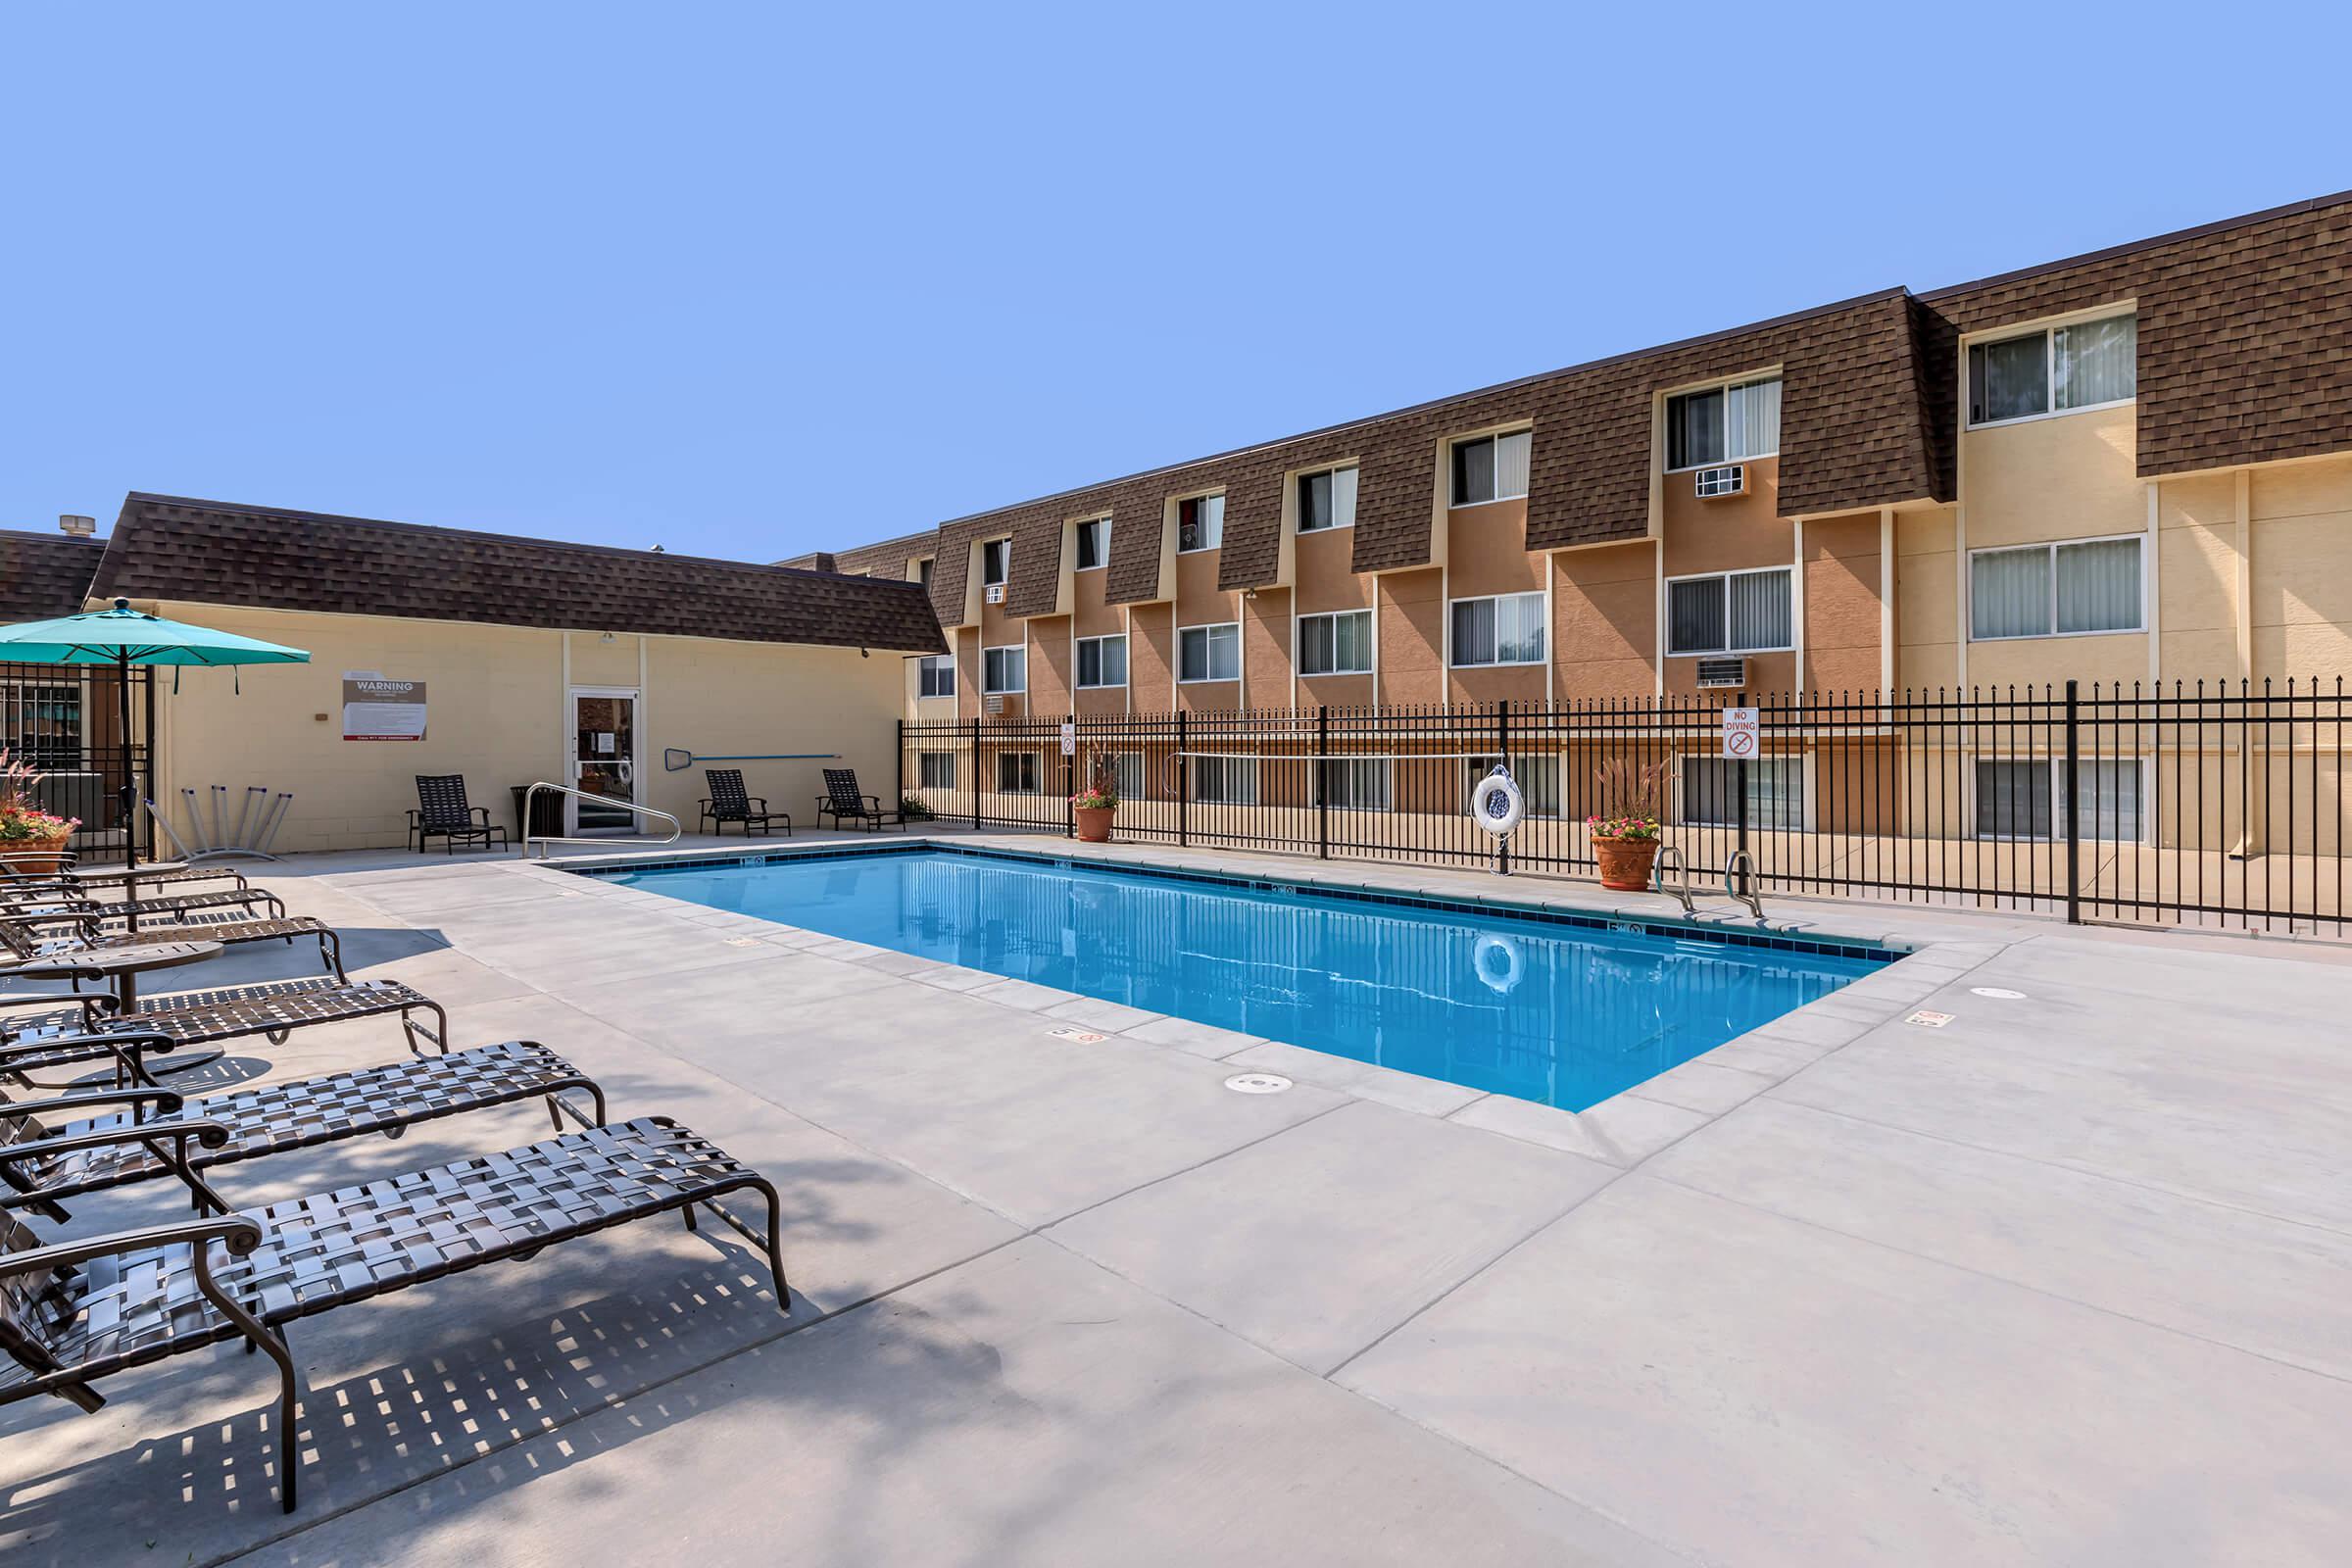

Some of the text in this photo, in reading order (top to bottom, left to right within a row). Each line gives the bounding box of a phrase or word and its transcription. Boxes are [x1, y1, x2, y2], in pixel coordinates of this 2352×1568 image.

[357, 681, 414, 691] WARNING
[1734, 711, 1747, 720] NO
[1726, 721, 1756, 731] DIVING
